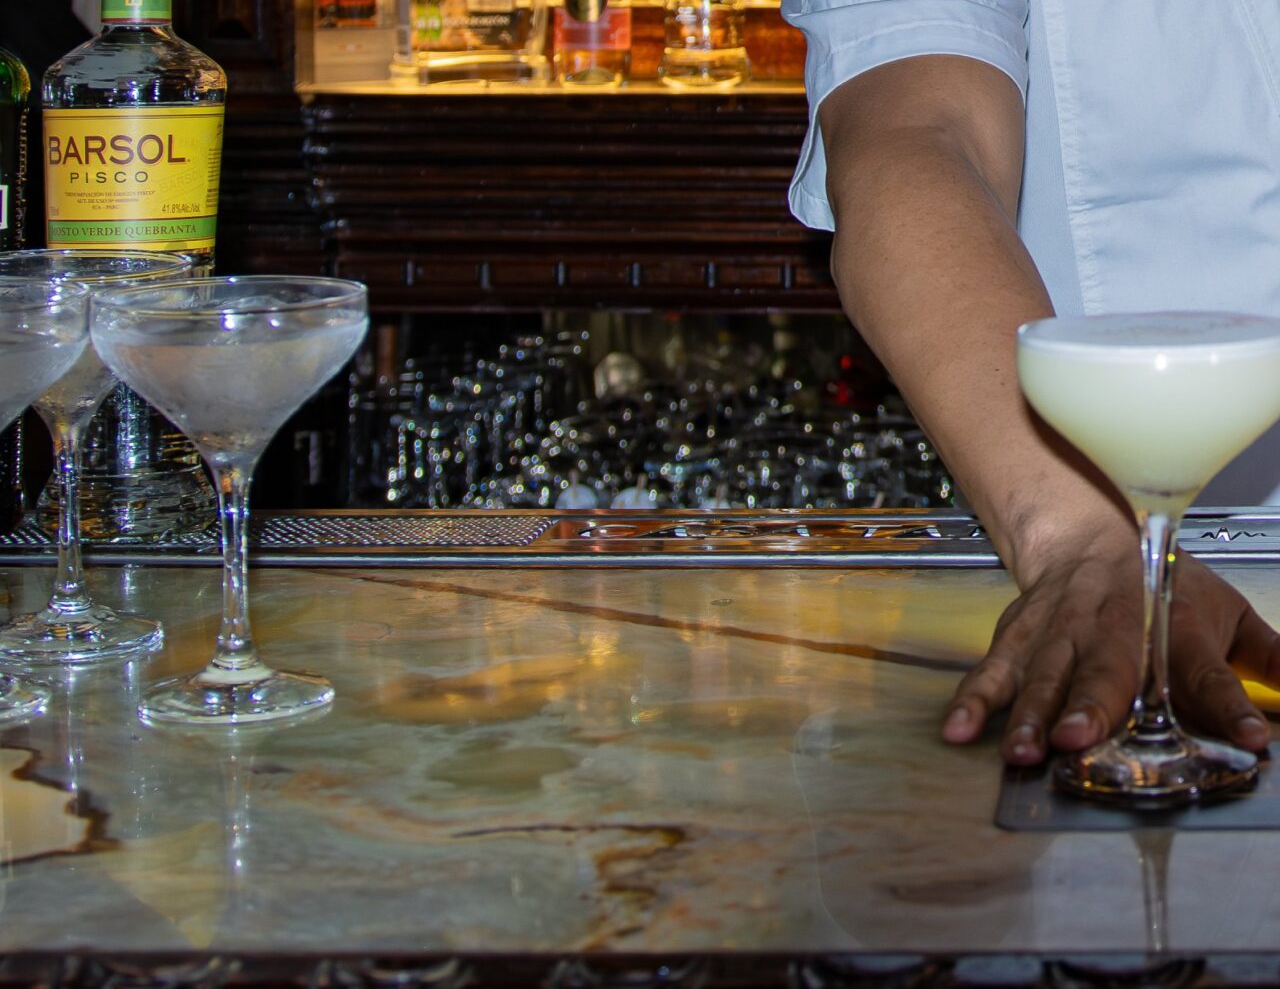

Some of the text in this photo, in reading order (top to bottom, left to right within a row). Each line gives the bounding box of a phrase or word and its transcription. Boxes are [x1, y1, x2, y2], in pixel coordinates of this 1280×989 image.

[48, 134, 186, 165] BARSOL
[70, 171, 149, 183] PISCO
[81, 226, 122, 236] VERDE
[124, 224, 197, 238] QUEBRANTA
